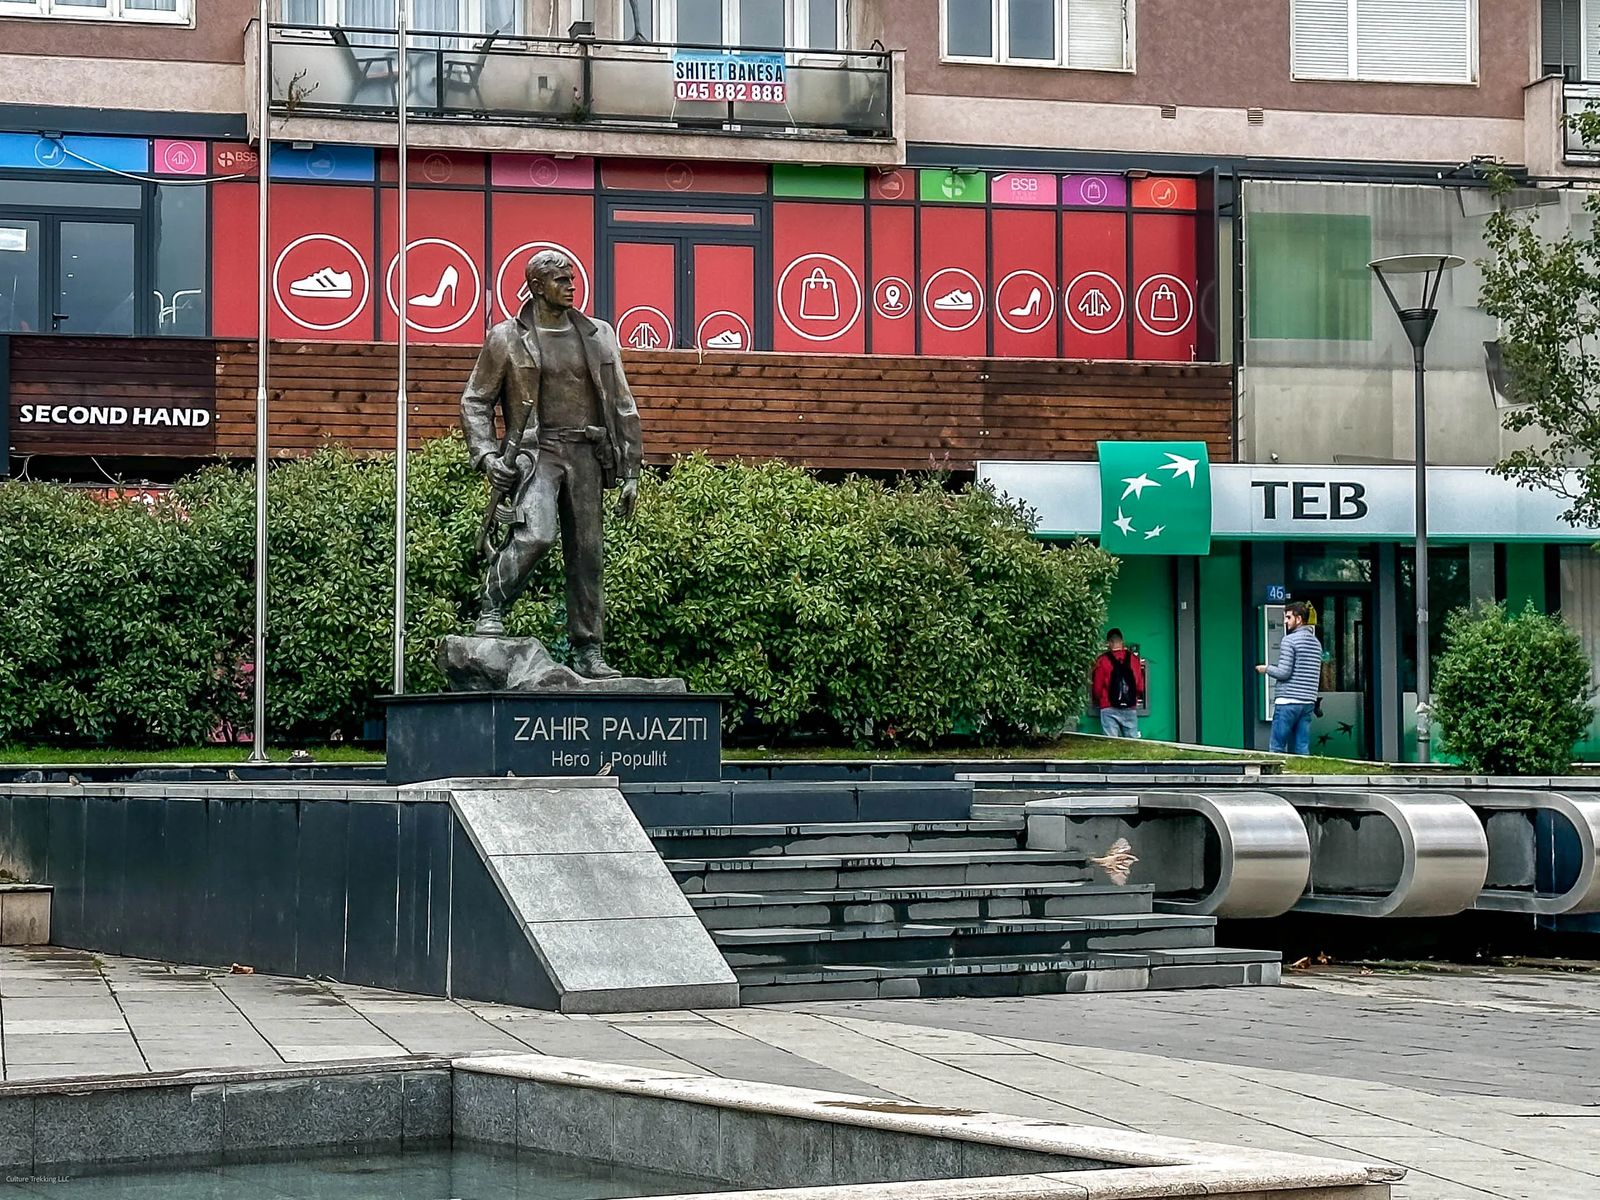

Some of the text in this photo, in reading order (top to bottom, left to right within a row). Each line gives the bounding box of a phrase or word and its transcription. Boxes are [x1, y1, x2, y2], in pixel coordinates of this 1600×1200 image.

[676, 61, 783, 82] SHITET BANESA
[676, 82, 783, 102] 045 882 888
[235, 151, 258, 162] BSB
[1011, 178, 1037, 191] BSB
[19, 405, 210, 427] SECOND HAND
[1250, 481, 1368, 520] TEB
[513, 717, 707, 741] ZAHIR PAJAZITI
[551, 751, 667, 770] Hero i Popullit
